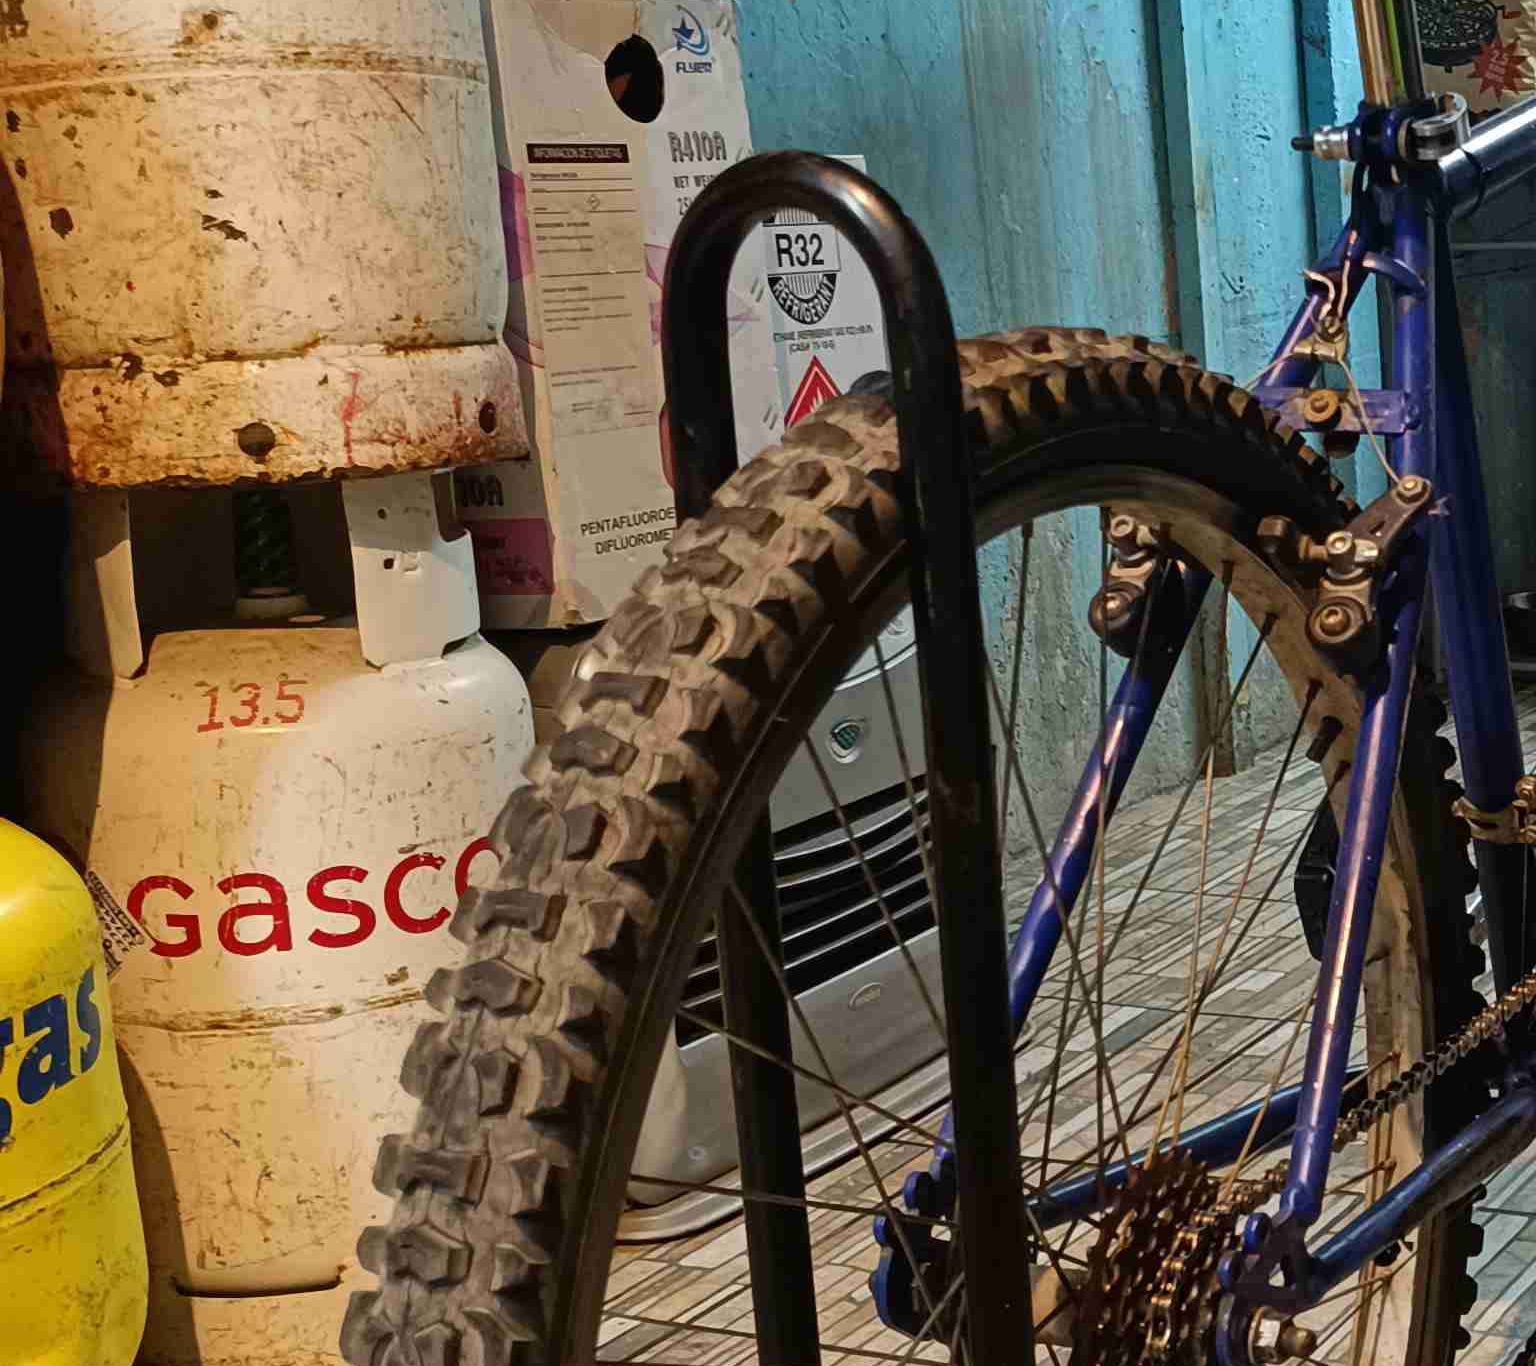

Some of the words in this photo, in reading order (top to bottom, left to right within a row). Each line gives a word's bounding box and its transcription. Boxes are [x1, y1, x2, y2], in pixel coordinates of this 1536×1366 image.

[775, 233, 824, 267] R32
[771, 278, 835, 323] REFRIGERANT
[196, 680, 308, 733] 13.5
